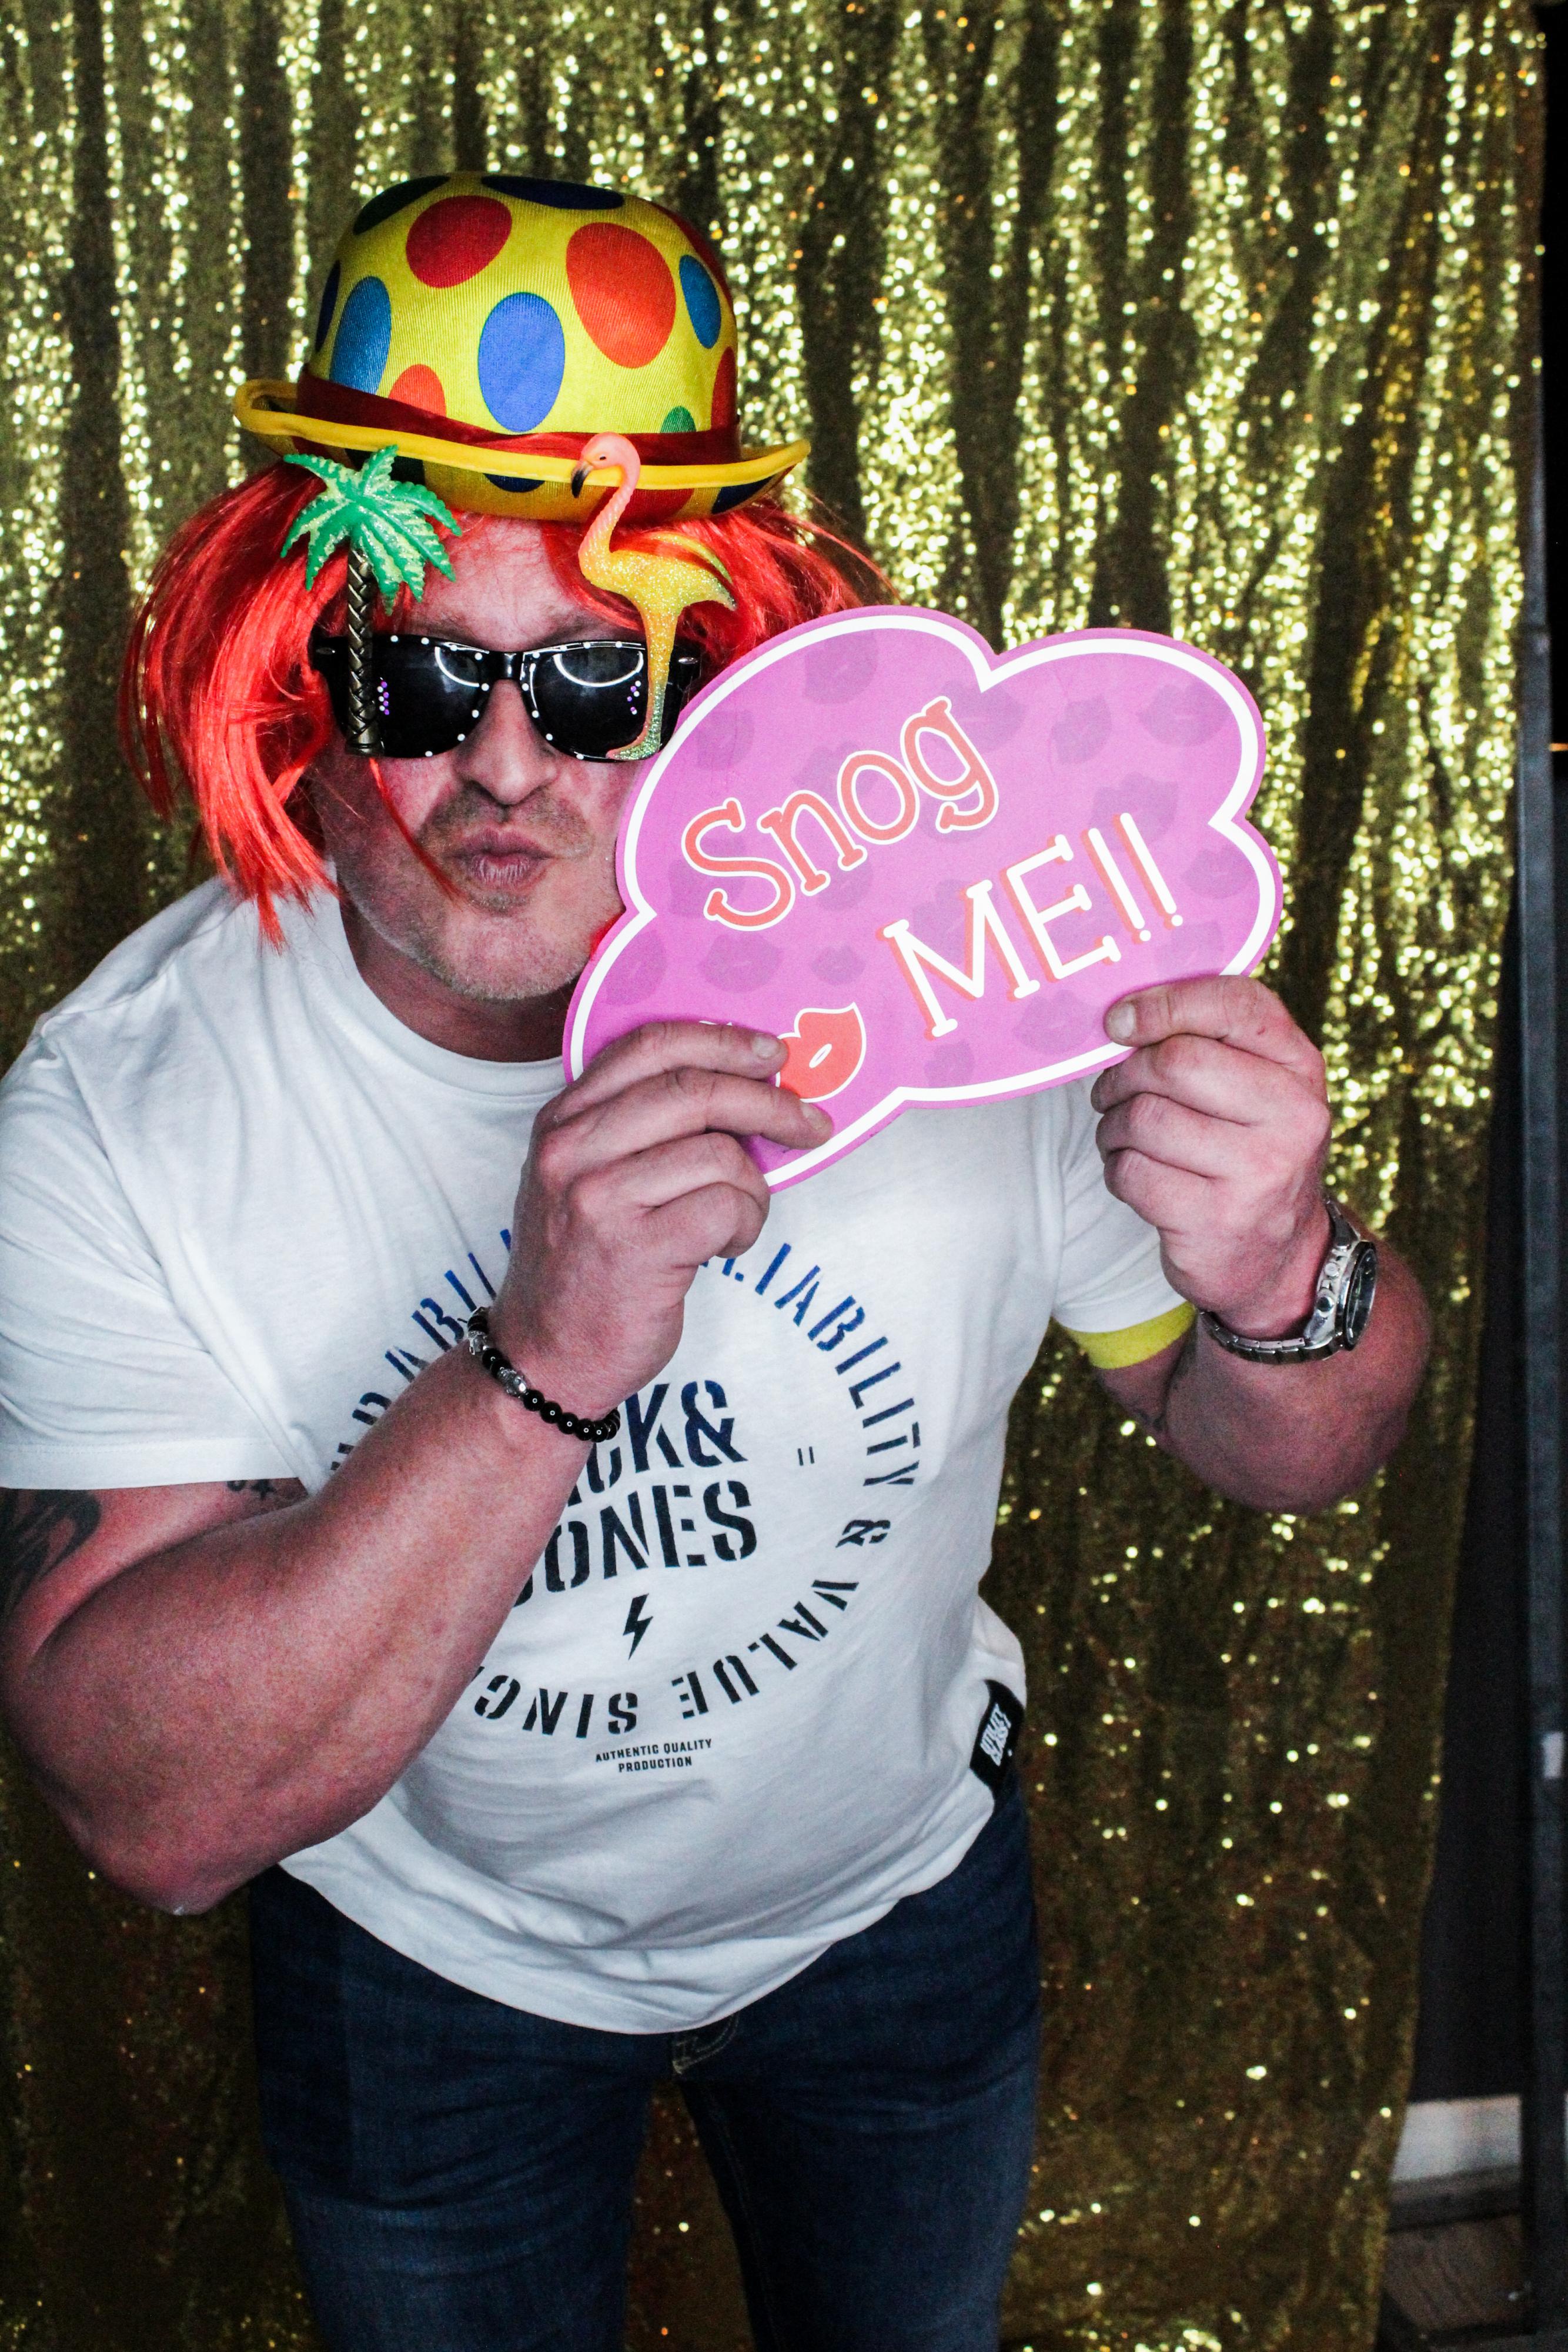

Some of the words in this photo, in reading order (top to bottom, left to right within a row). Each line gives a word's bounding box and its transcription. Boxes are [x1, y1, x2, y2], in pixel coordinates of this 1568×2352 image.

[681, 695, 999, 931] Snog
[876, 812, 1183, 1040] ME!!
[513, 1480, 757, 1608] ONES
[472, 1666, 638, 1739] SINC
[671, 1579, 860, 1719] VALUE
[596, 1744, 659, 1763] AUTHENTIC
[663, 1738, 712, 1755] QUALITY
[618, 1756, 693, 1773] PRODUCTION
